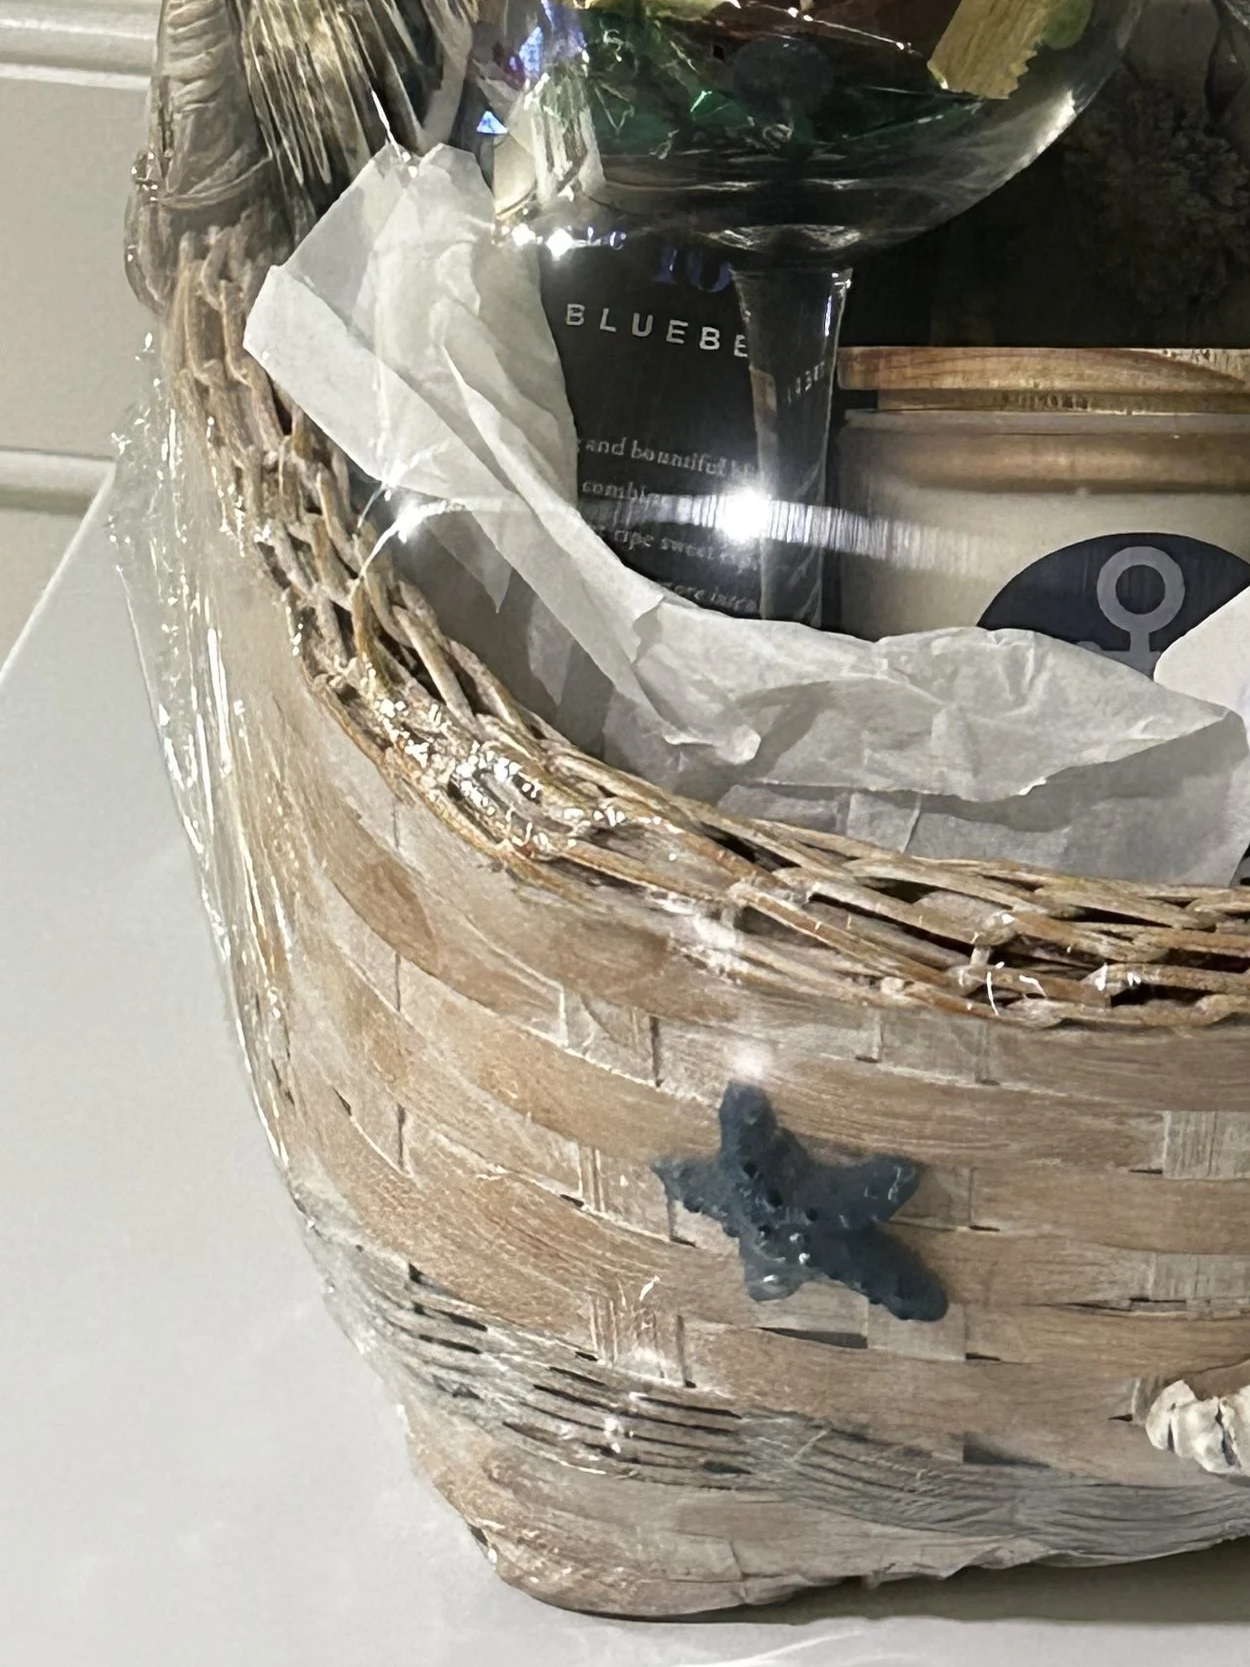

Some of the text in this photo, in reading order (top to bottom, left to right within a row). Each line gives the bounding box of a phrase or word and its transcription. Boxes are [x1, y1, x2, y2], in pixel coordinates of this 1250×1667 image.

[566, 303, 749, 358] BLUEBE
[585, 436, 626, 456] and
[631, 439, 727, 477] bountiful
